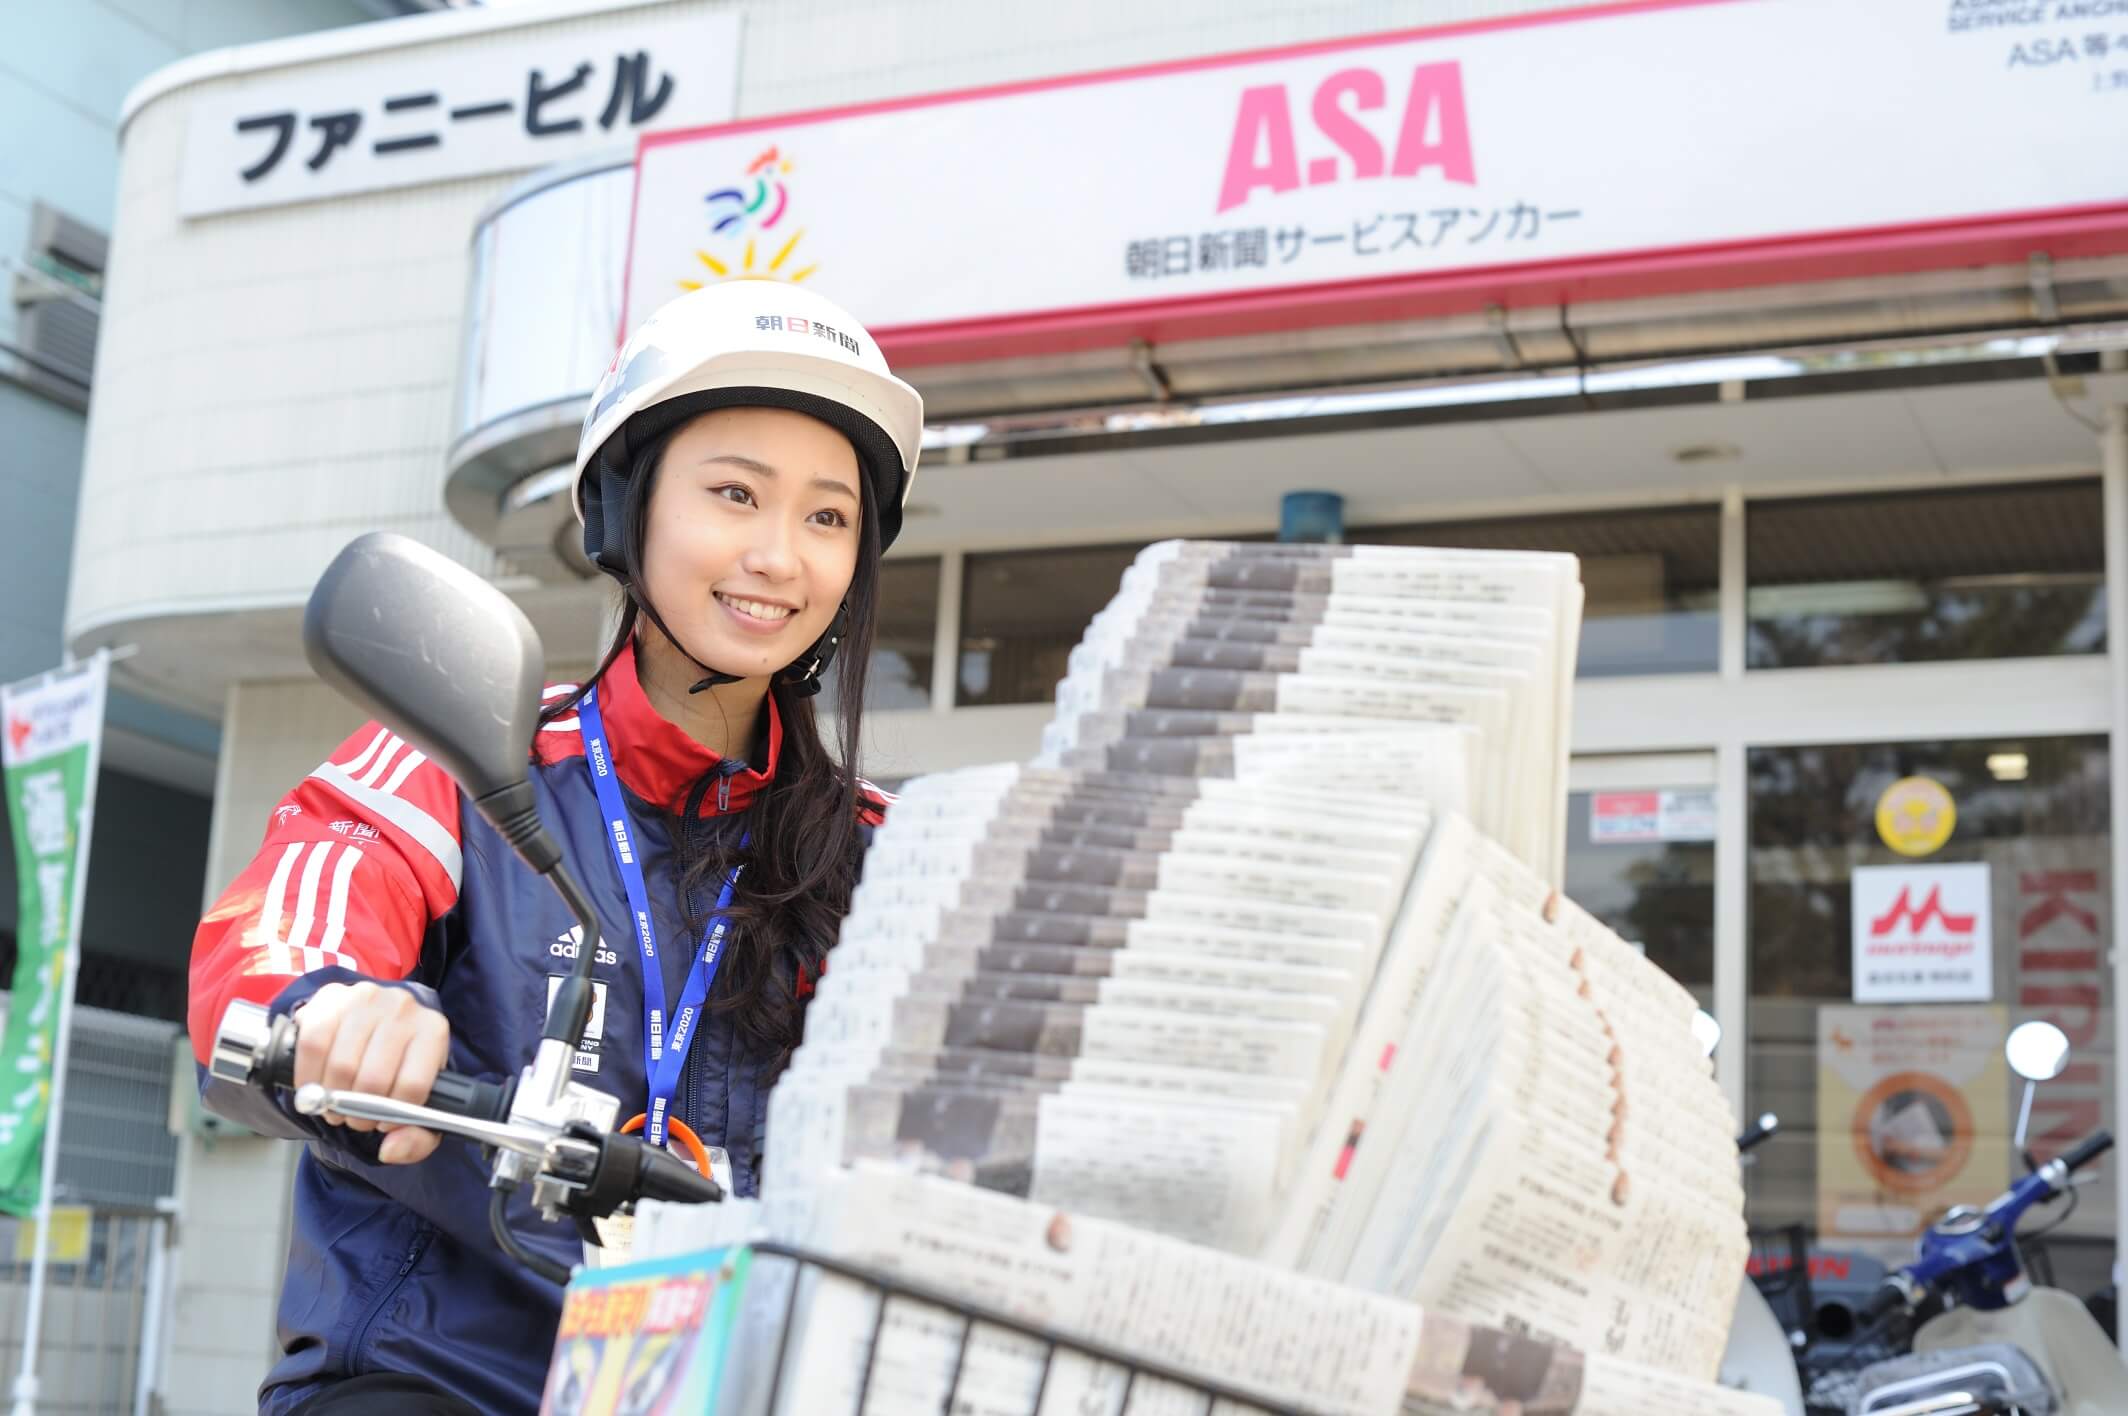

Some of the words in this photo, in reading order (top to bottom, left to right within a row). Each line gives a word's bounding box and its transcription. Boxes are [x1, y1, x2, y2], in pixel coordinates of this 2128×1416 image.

[2008, 36, 2079, 69] ASA
[237, 51, 675, 182] ファニービル
[1216, 60, 1477, 214] ASA
[1125, 201, 1582, 279] 朝日新聞サービスアンカー
[754, 315, 860, 356] 朝日新聞
[671, 1007, 694, 1052] 東京2020
